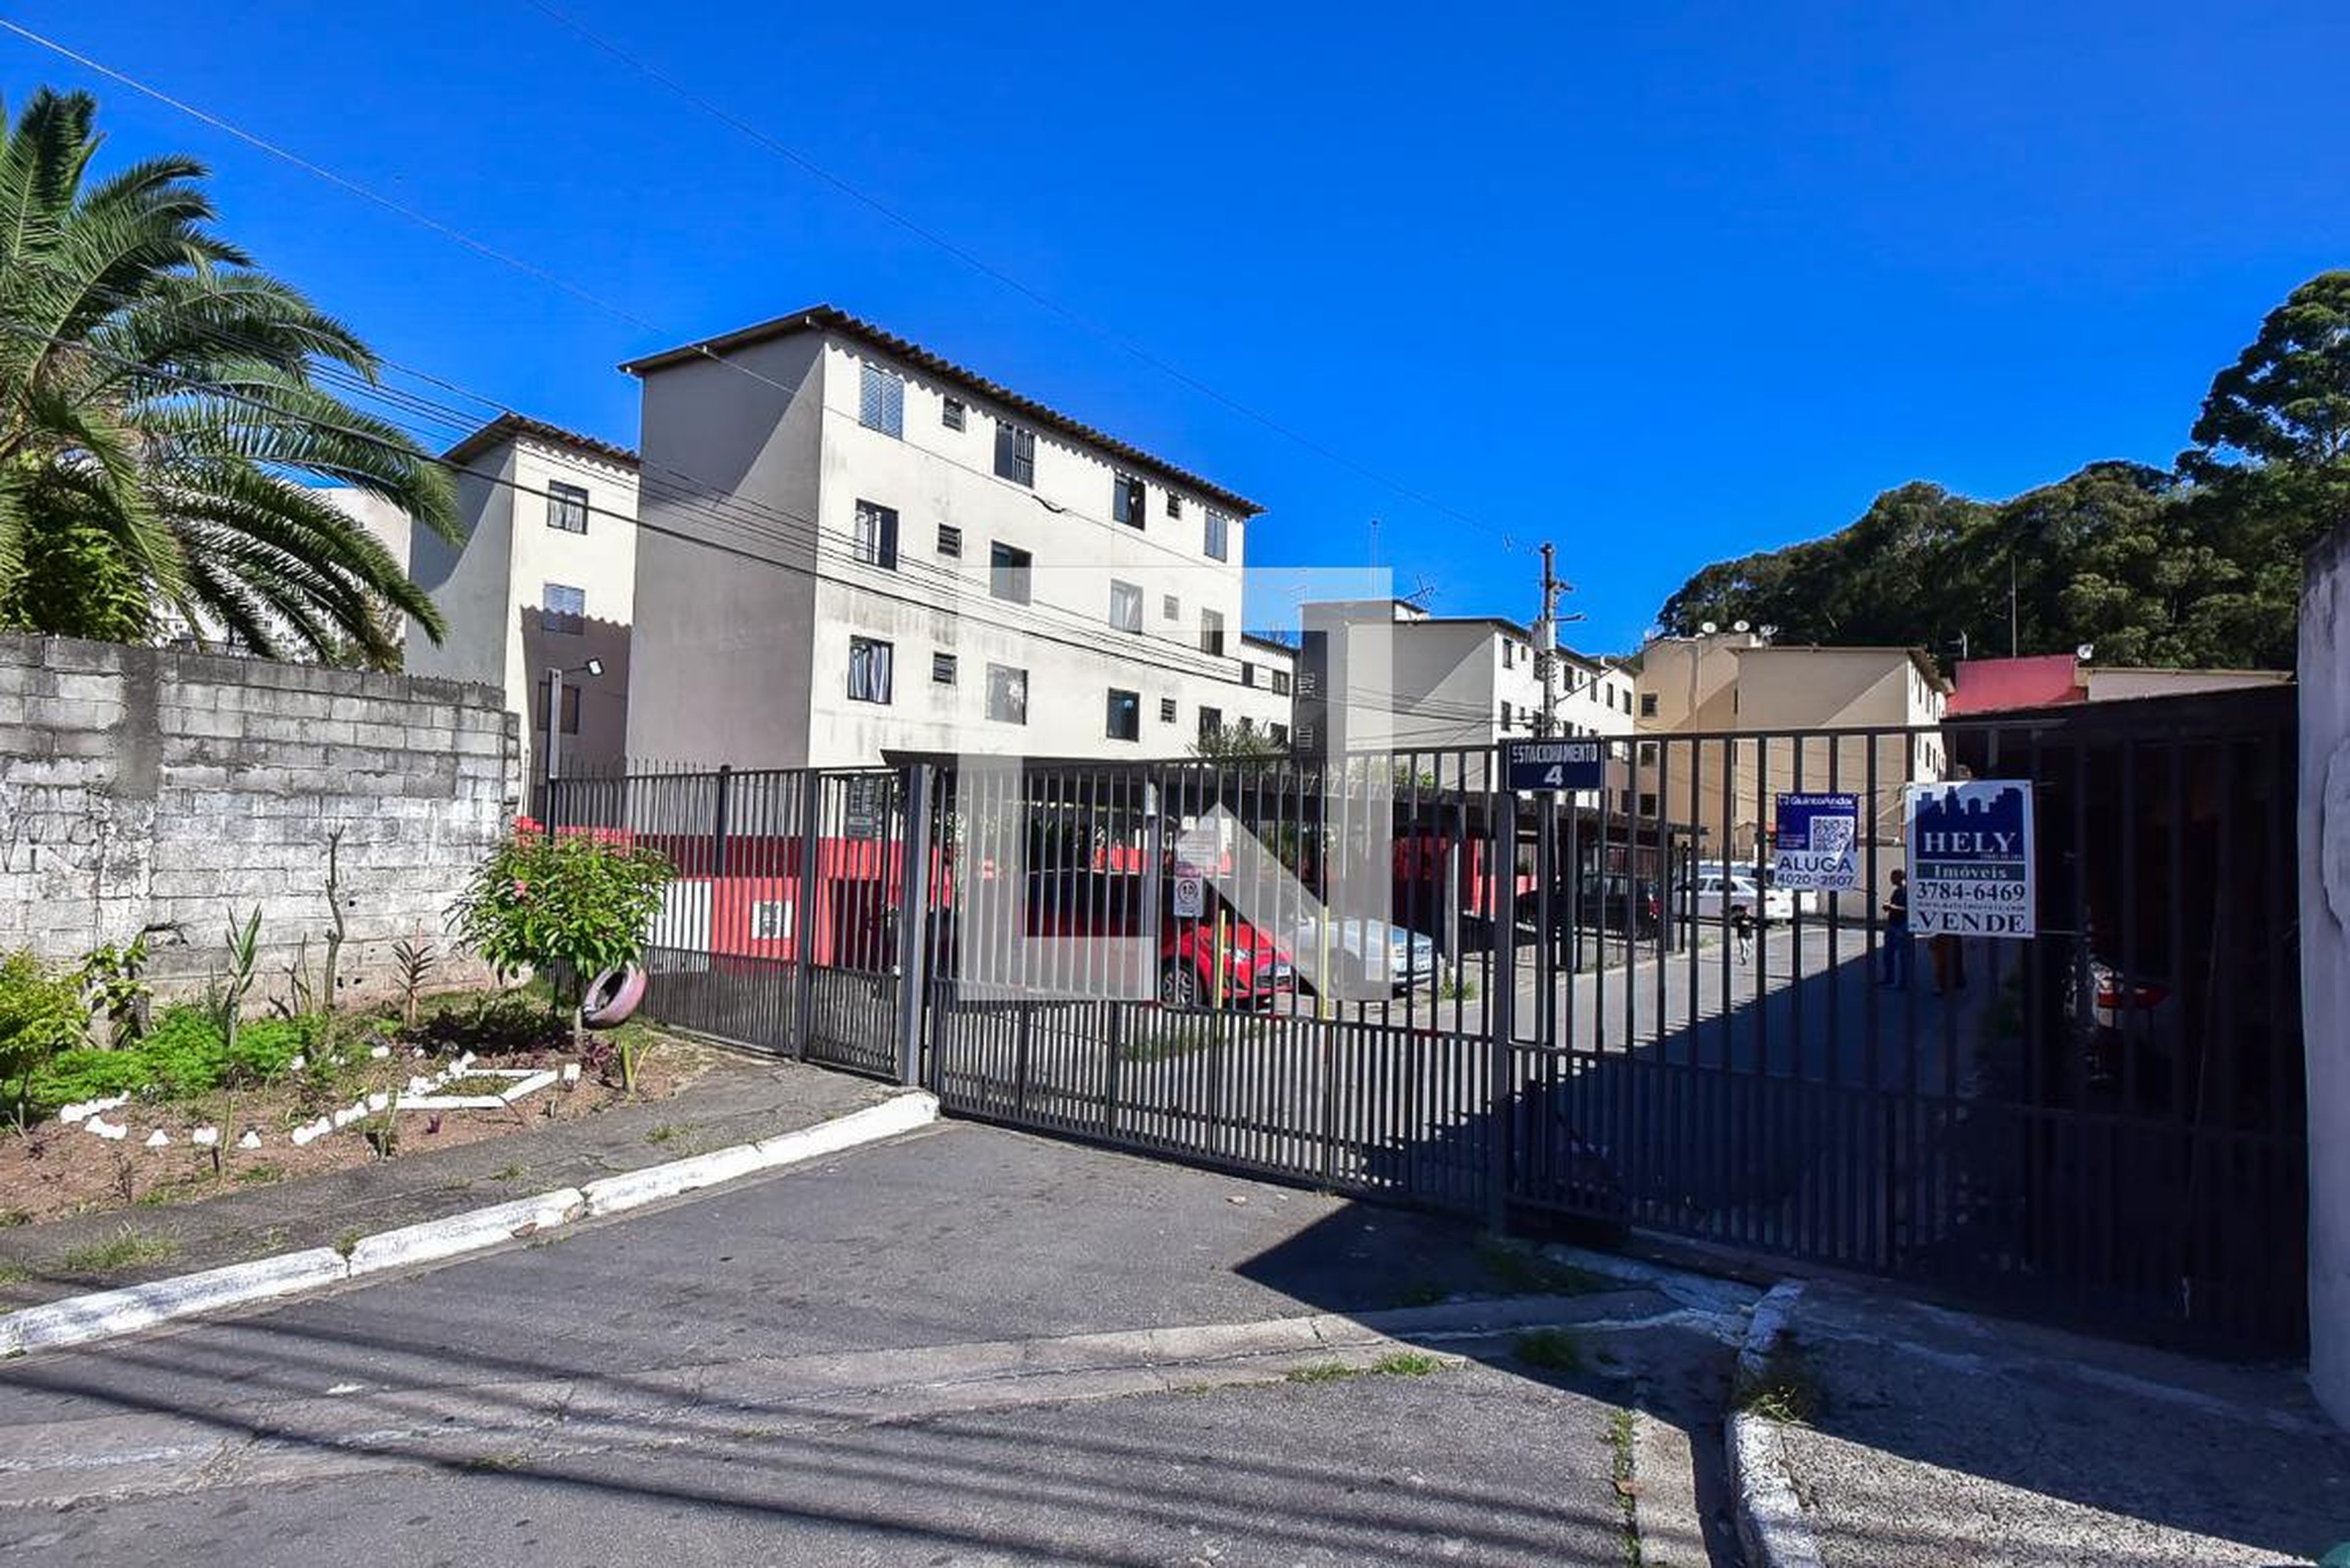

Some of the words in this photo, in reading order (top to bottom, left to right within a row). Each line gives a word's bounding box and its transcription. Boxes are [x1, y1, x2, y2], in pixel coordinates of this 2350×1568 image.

[1544, 766, 1563, 786] 4
[1924, 832, 2016, 853] HELY
[1778, 856, 1853, 873] ALUGA
[1934, 865, 2007, 878] Imóveis
[1917, 881, 2026, 901] 3784-6469
[1919, 911, 2026, 933] VENDE
